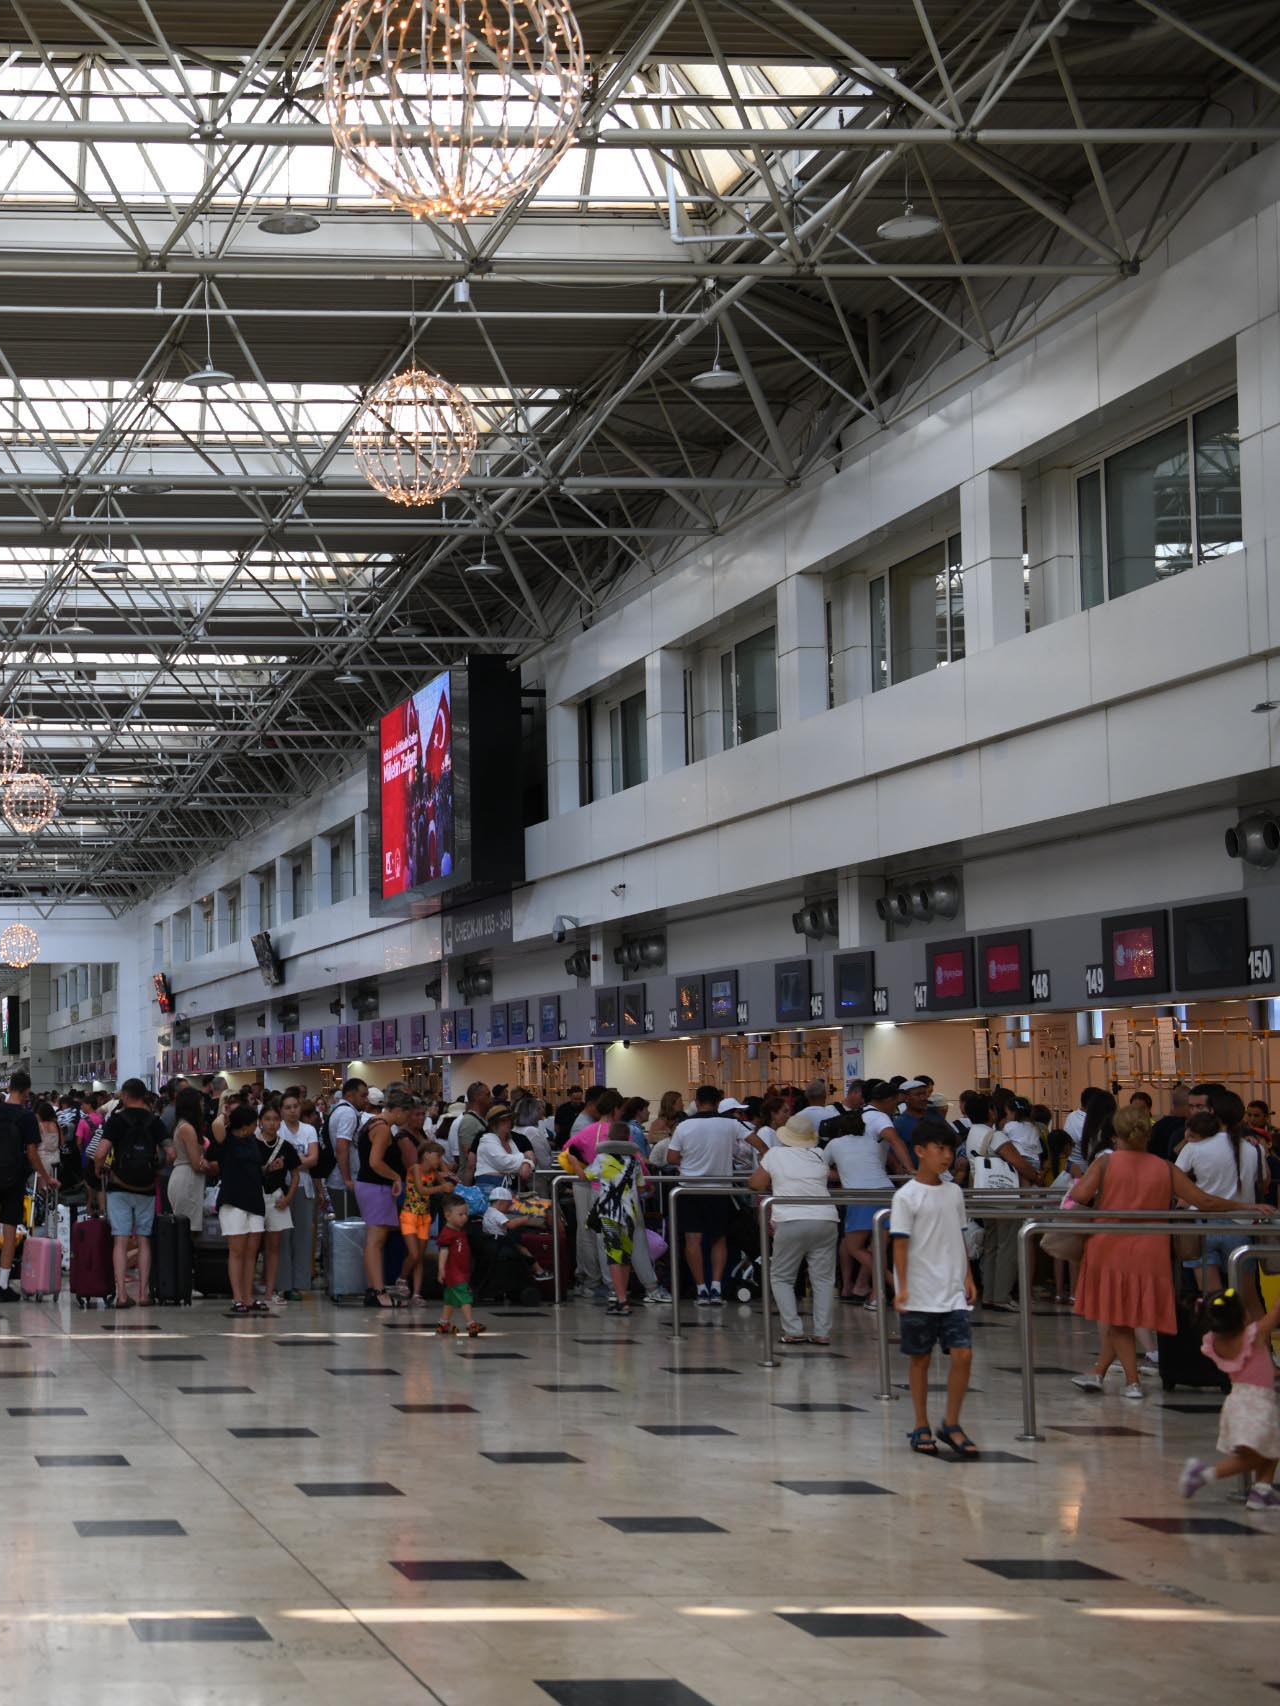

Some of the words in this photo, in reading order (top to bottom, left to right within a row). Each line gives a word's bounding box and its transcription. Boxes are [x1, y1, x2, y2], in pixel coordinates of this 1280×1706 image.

[1248, 949, 1271, 980] 150
[1032, 973, 1049, 999] 148
[1086, 967, 1104, 994] 149
[811, 996, 823, 1017] 145
[874, 990, 887, 1012] 146
[914, 985, 928, 1008] 147
